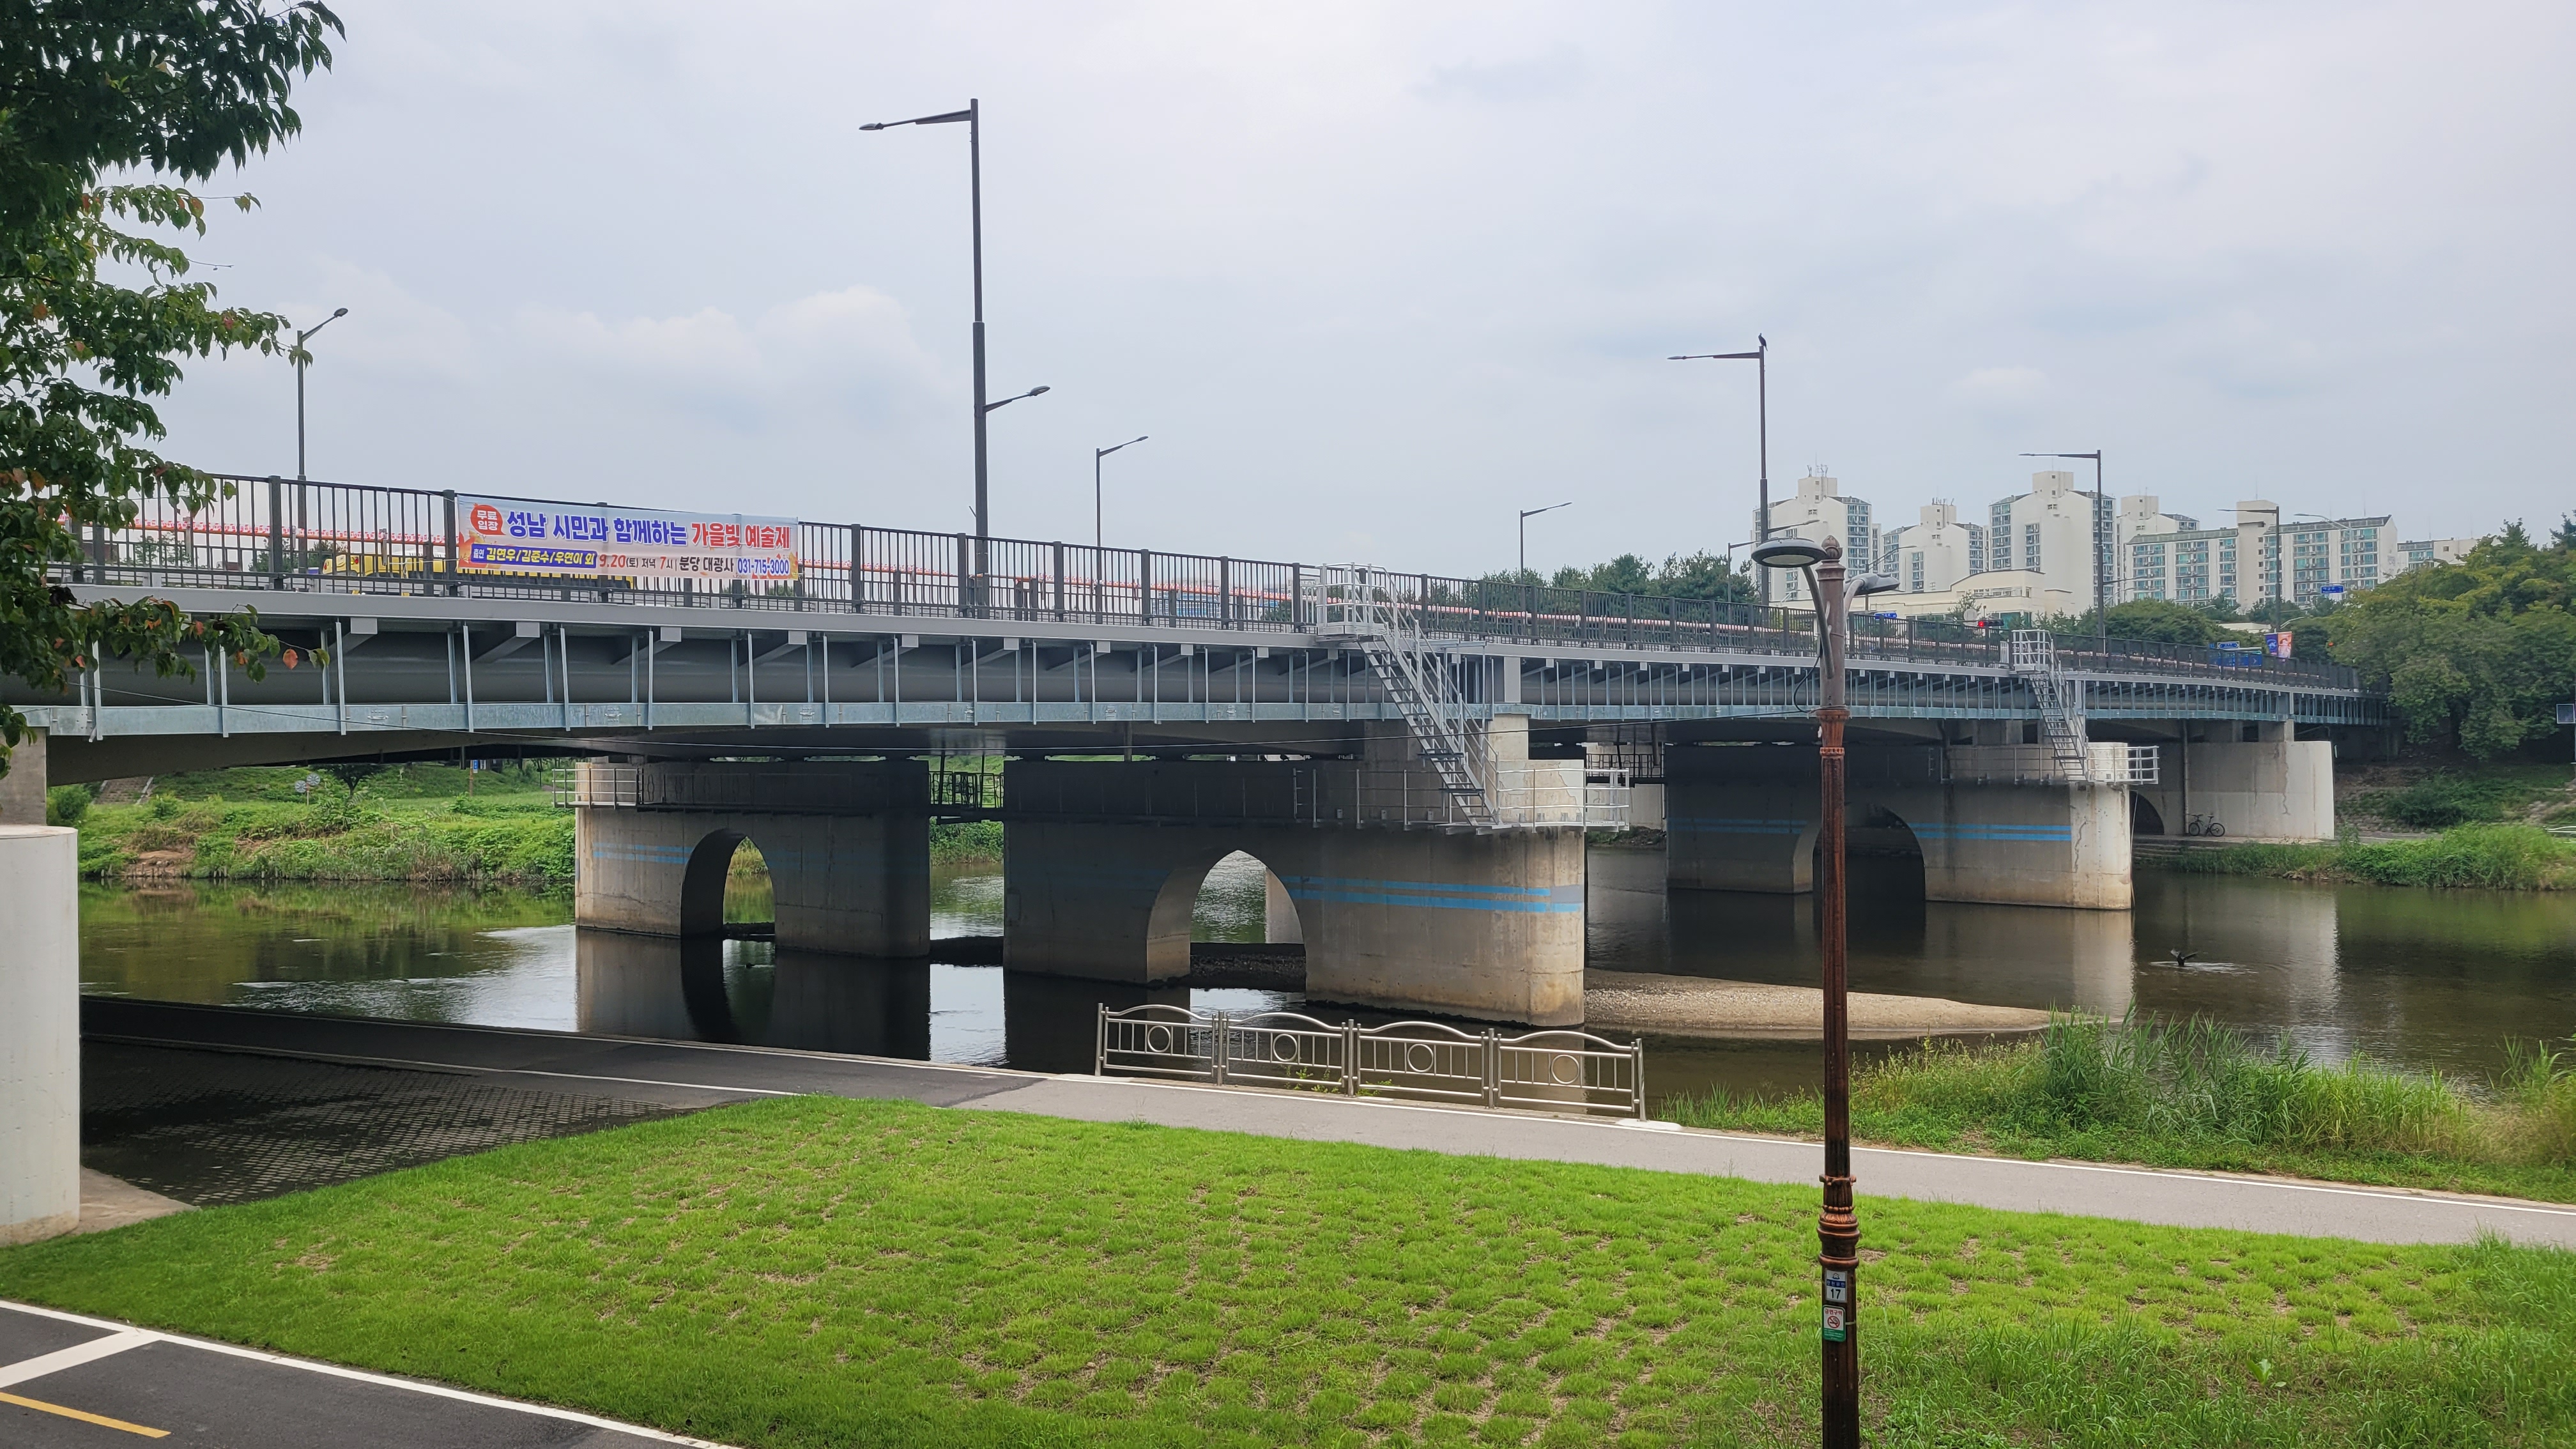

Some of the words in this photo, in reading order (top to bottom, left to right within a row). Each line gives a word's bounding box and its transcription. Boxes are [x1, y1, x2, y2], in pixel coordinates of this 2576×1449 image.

[477, 510, 497, 521] 무료
[477, 521, 498, 531] 입장
[507, 511, 546, 539] 성남
[553, 514, 609, 542] 시민과
[613, 518, 687, 546] 함께하는
[691, 522, 740, 548] 가을빛
[744, 525, 790, 549] 예술제
[584, 553, 595, 565] 외
[599, 554, 639, 569] 9.20(토)
[641, 557, 656, 569] 저녁
[678, 556, 700, 572] 분당
[703, 556, 734, 573] 대광사
[737, 558, 790, 574] 031-715-3000
[1830, 1288, 1841, 1300] 17
[1825, 1308, 1843, 1317] 금연구역
